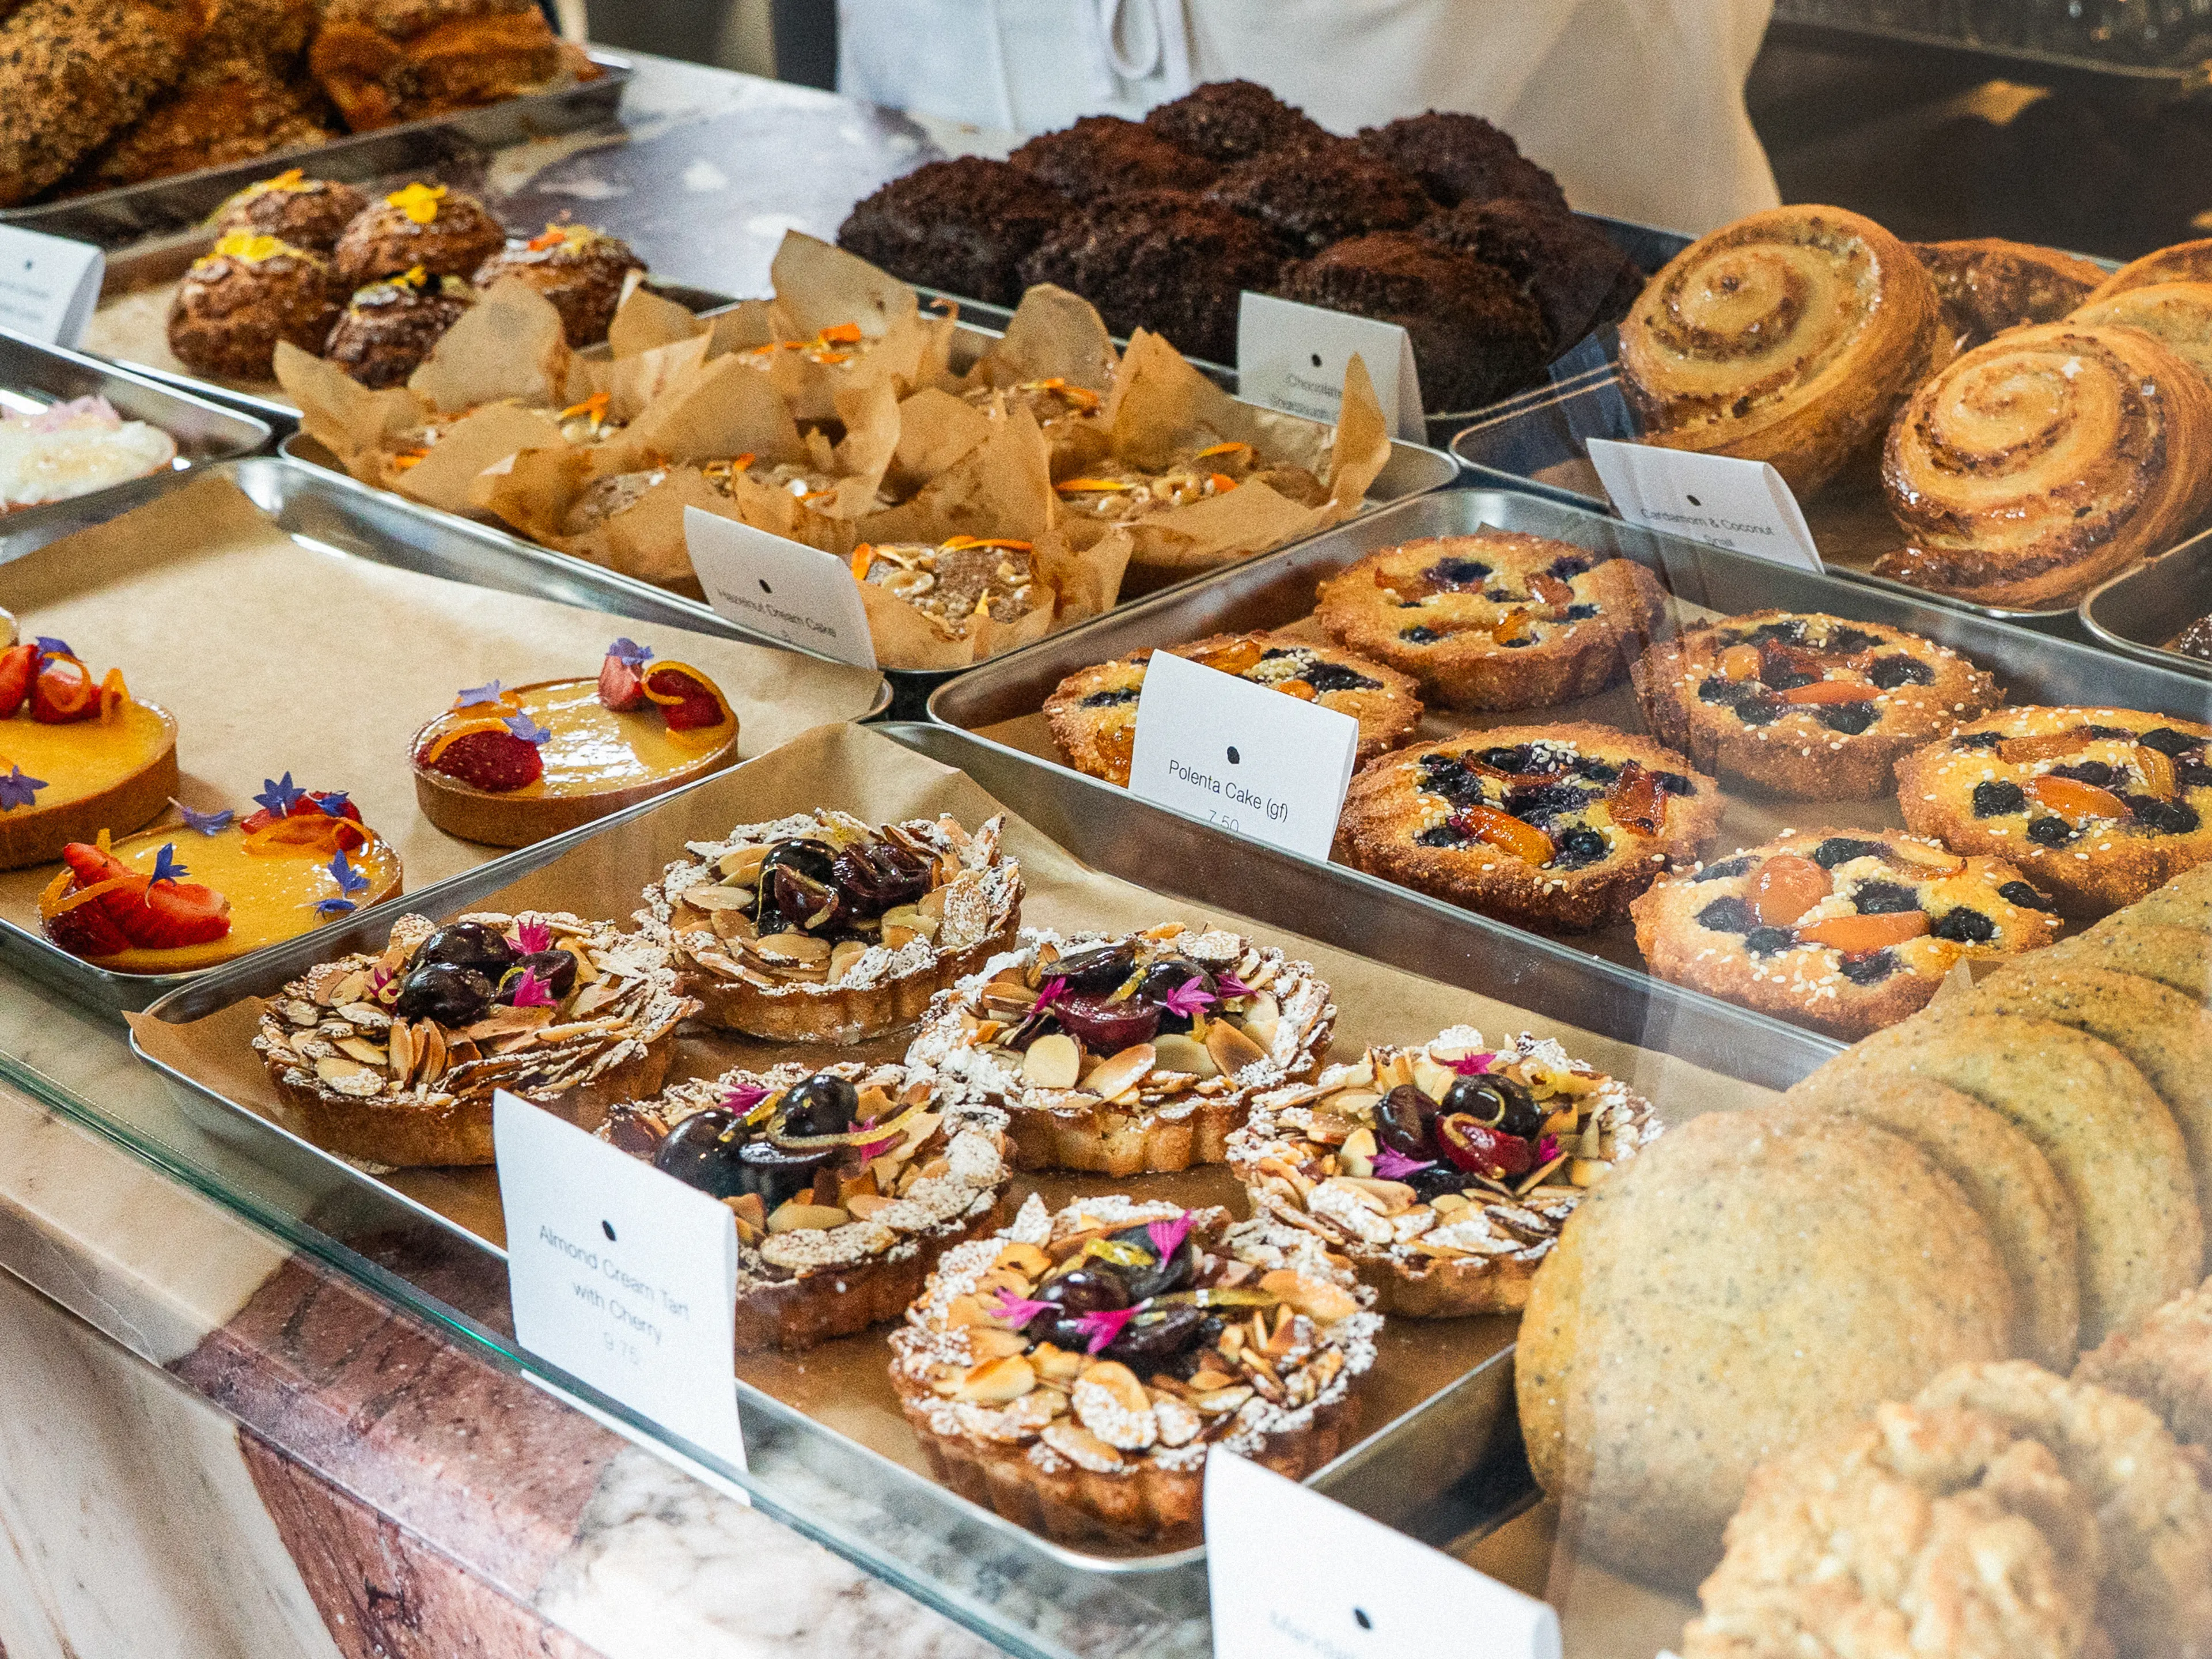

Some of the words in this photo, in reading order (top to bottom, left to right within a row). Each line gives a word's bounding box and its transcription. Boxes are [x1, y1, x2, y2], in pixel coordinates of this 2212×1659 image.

[1709, 517, 1720, 528] &
[1721, 519, 1775, 536] Coconut
[766, 603, 805, 627] Cream
[1169, 759, 1220, 794] Polenta
[1225, 782, 1262, 810] Cake
[1266, 798, 1289, 823] (gf)
[539, 1225, 598, 1270] Almond
[603, 1259, 655, 1301] Cream
[573, 1282, 605, 1310] with
[610, 1300, 662, 1345] Cherry
[603, 1331, 641, 1366] 975
